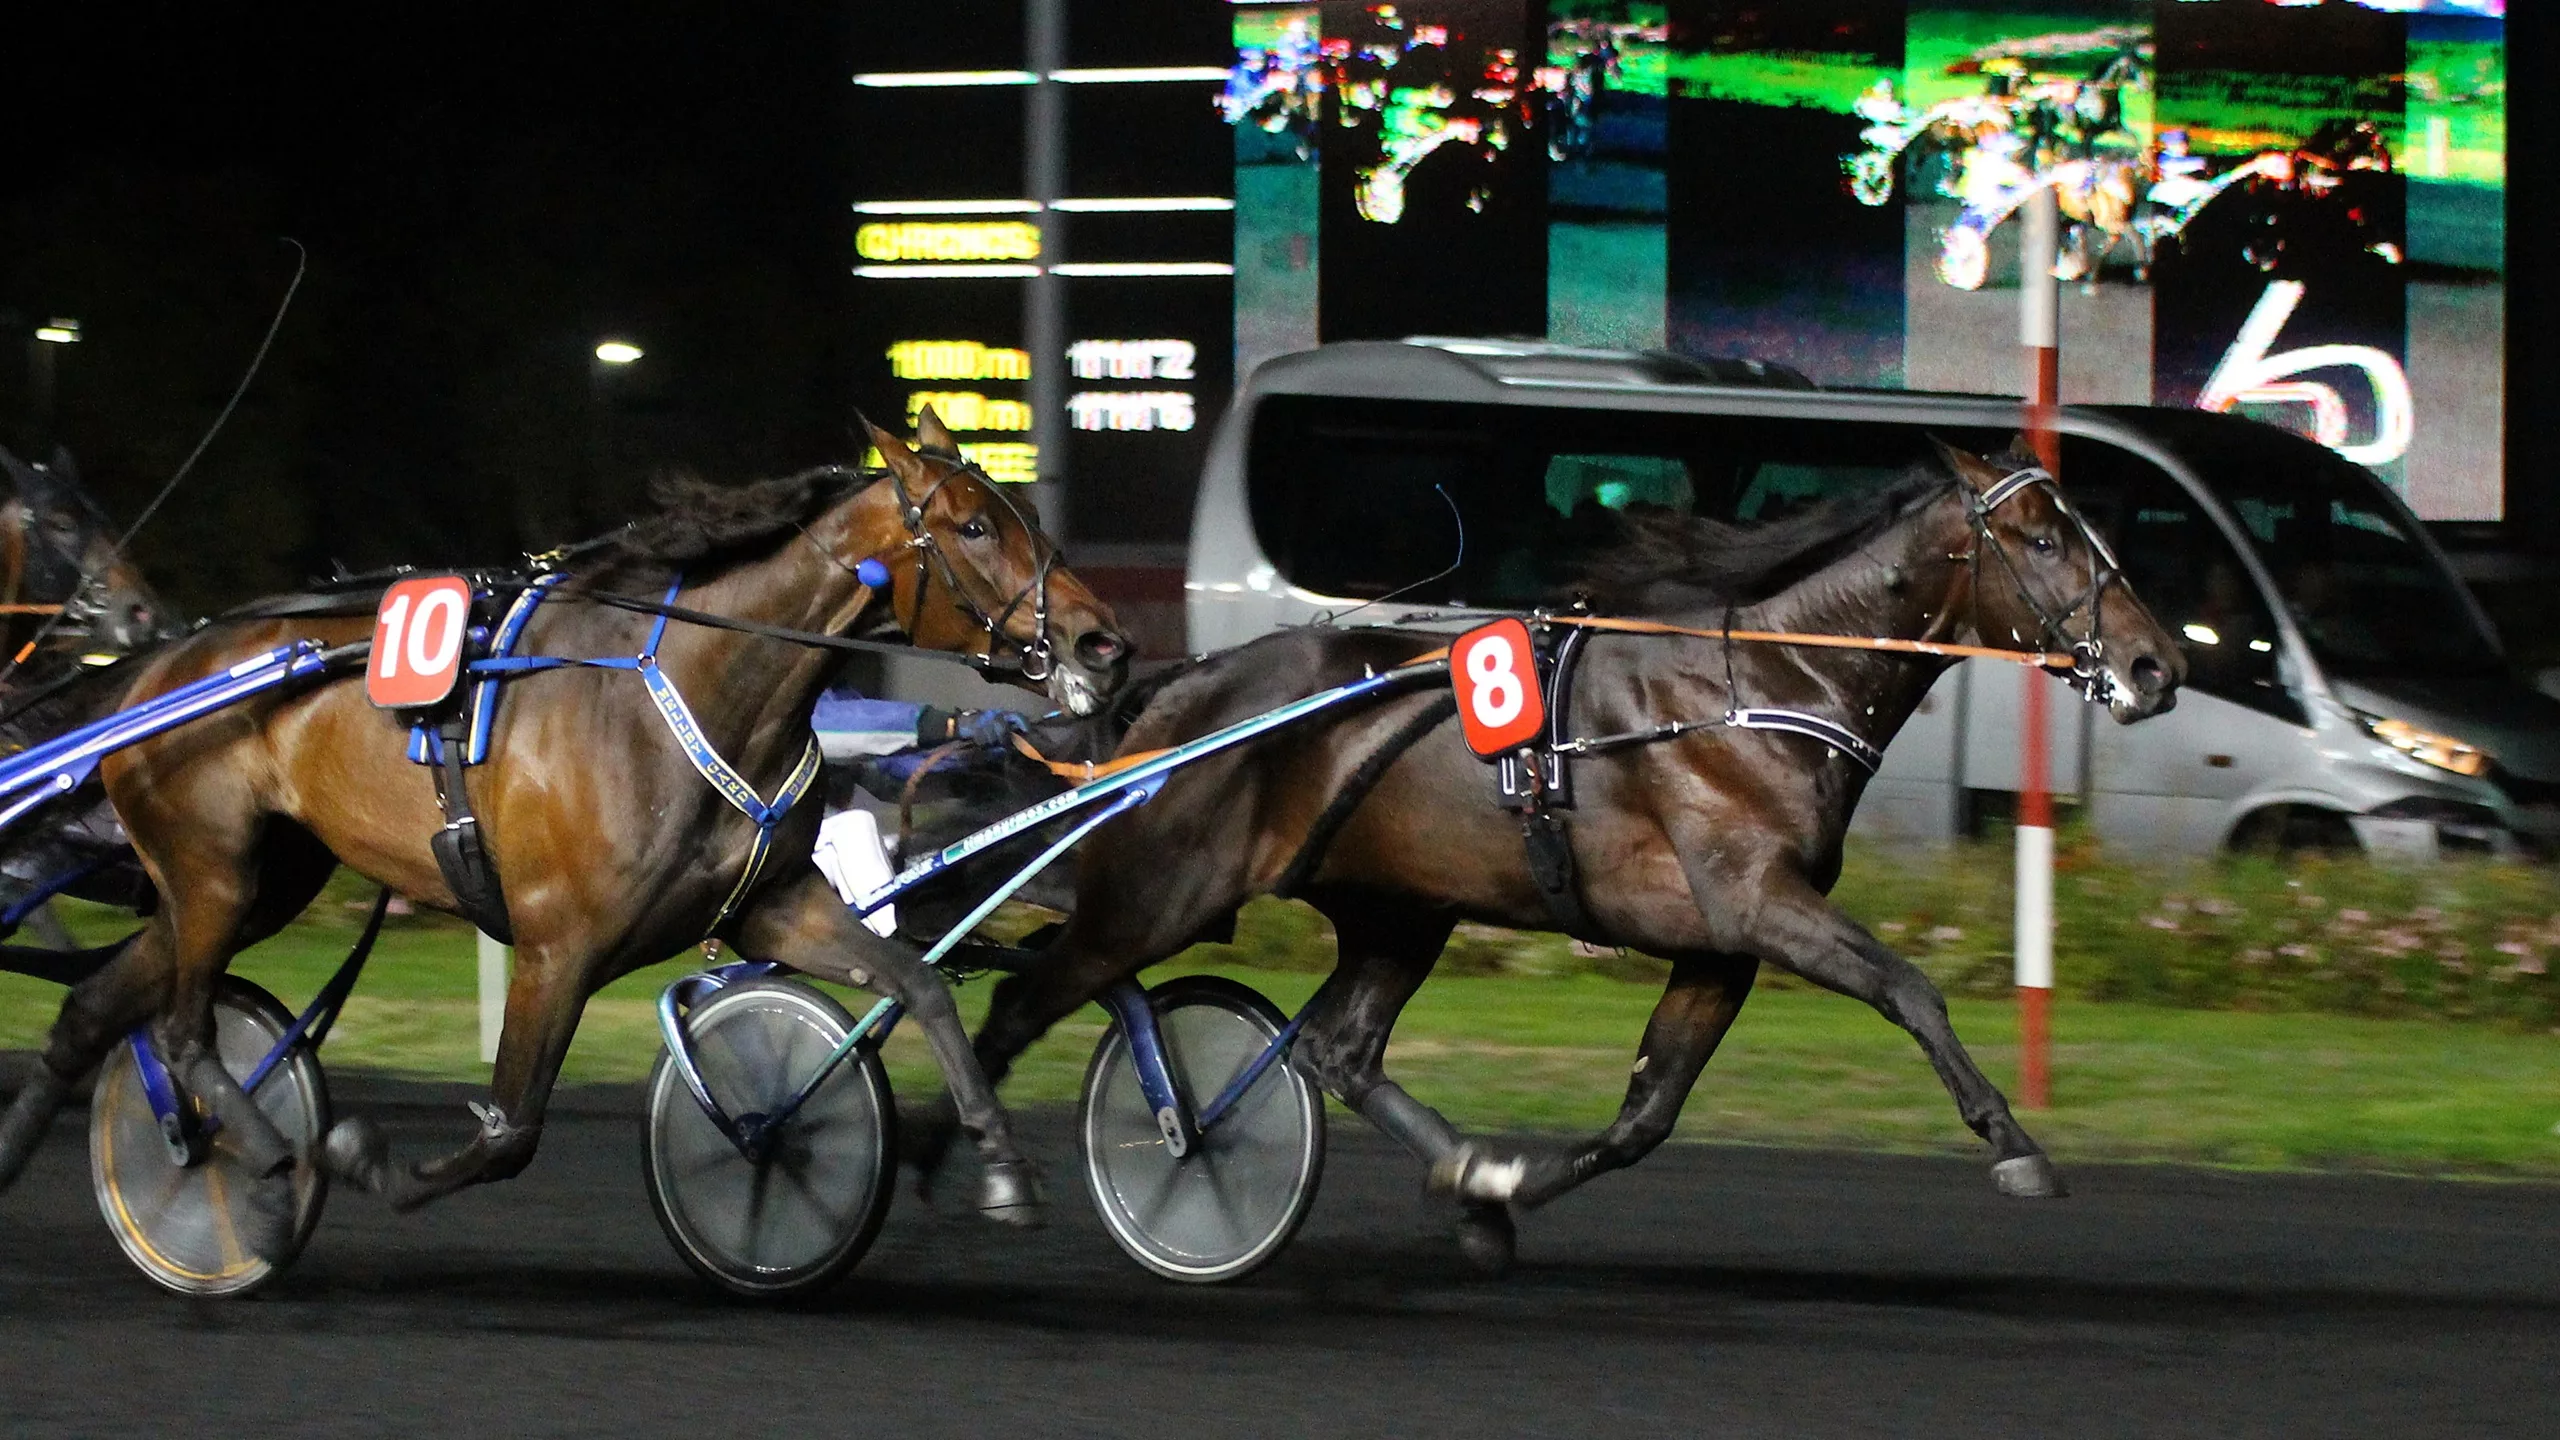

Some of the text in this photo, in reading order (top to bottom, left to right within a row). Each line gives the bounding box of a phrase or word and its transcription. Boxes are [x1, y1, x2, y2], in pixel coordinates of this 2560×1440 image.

[856, 222, 1042, 261] CHRONOS
[380, 588, 465, 679] 10
[1466, 635, 1524, 728] 8
